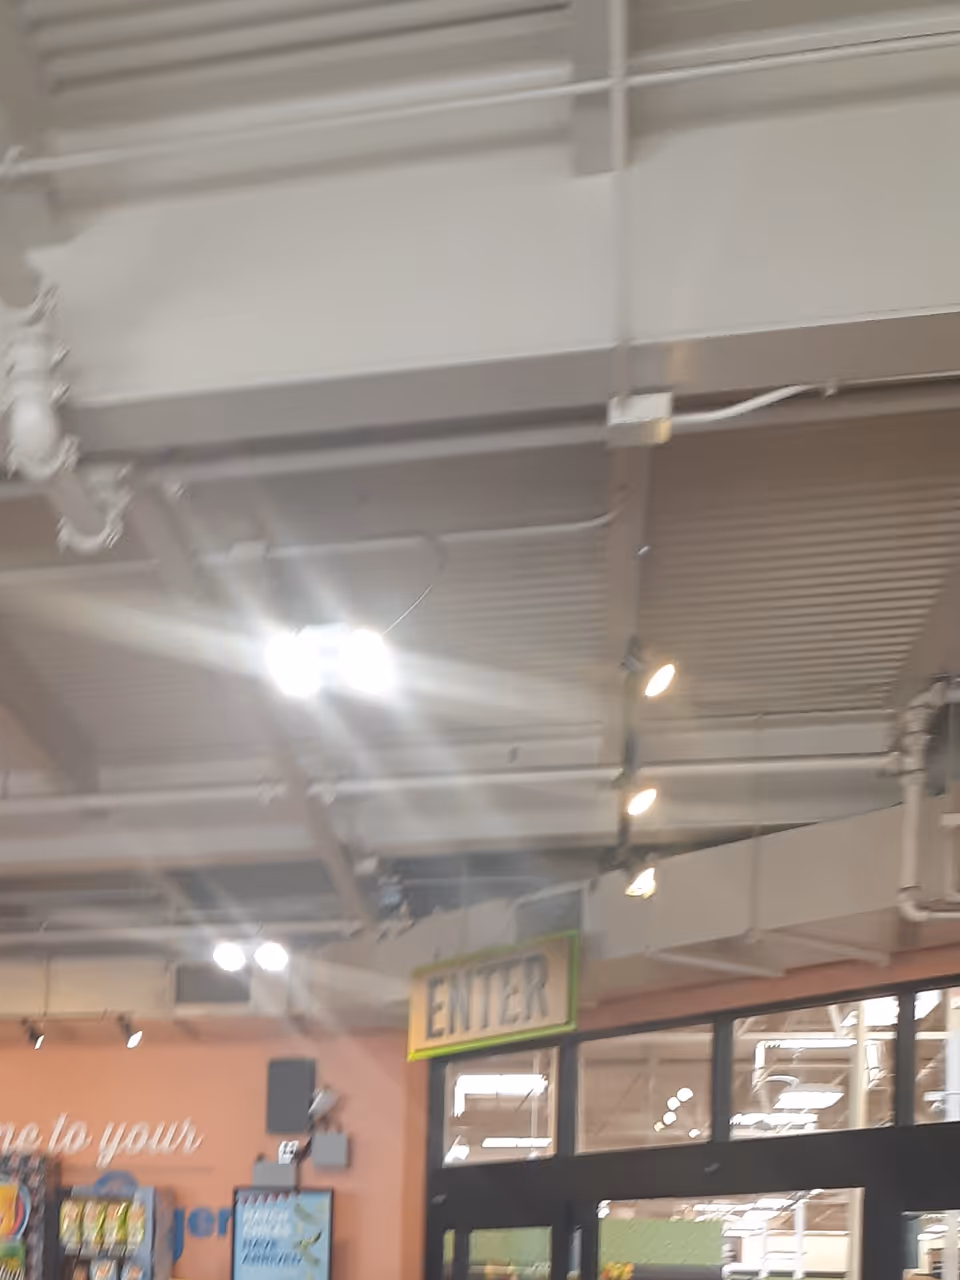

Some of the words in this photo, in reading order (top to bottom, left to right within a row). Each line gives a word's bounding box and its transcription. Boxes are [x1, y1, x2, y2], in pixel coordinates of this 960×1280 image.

[426, 953, 548, 1040] ENTER
[48, 1111, 93, 1154] to
[96, 1117, 203, 1169] your
